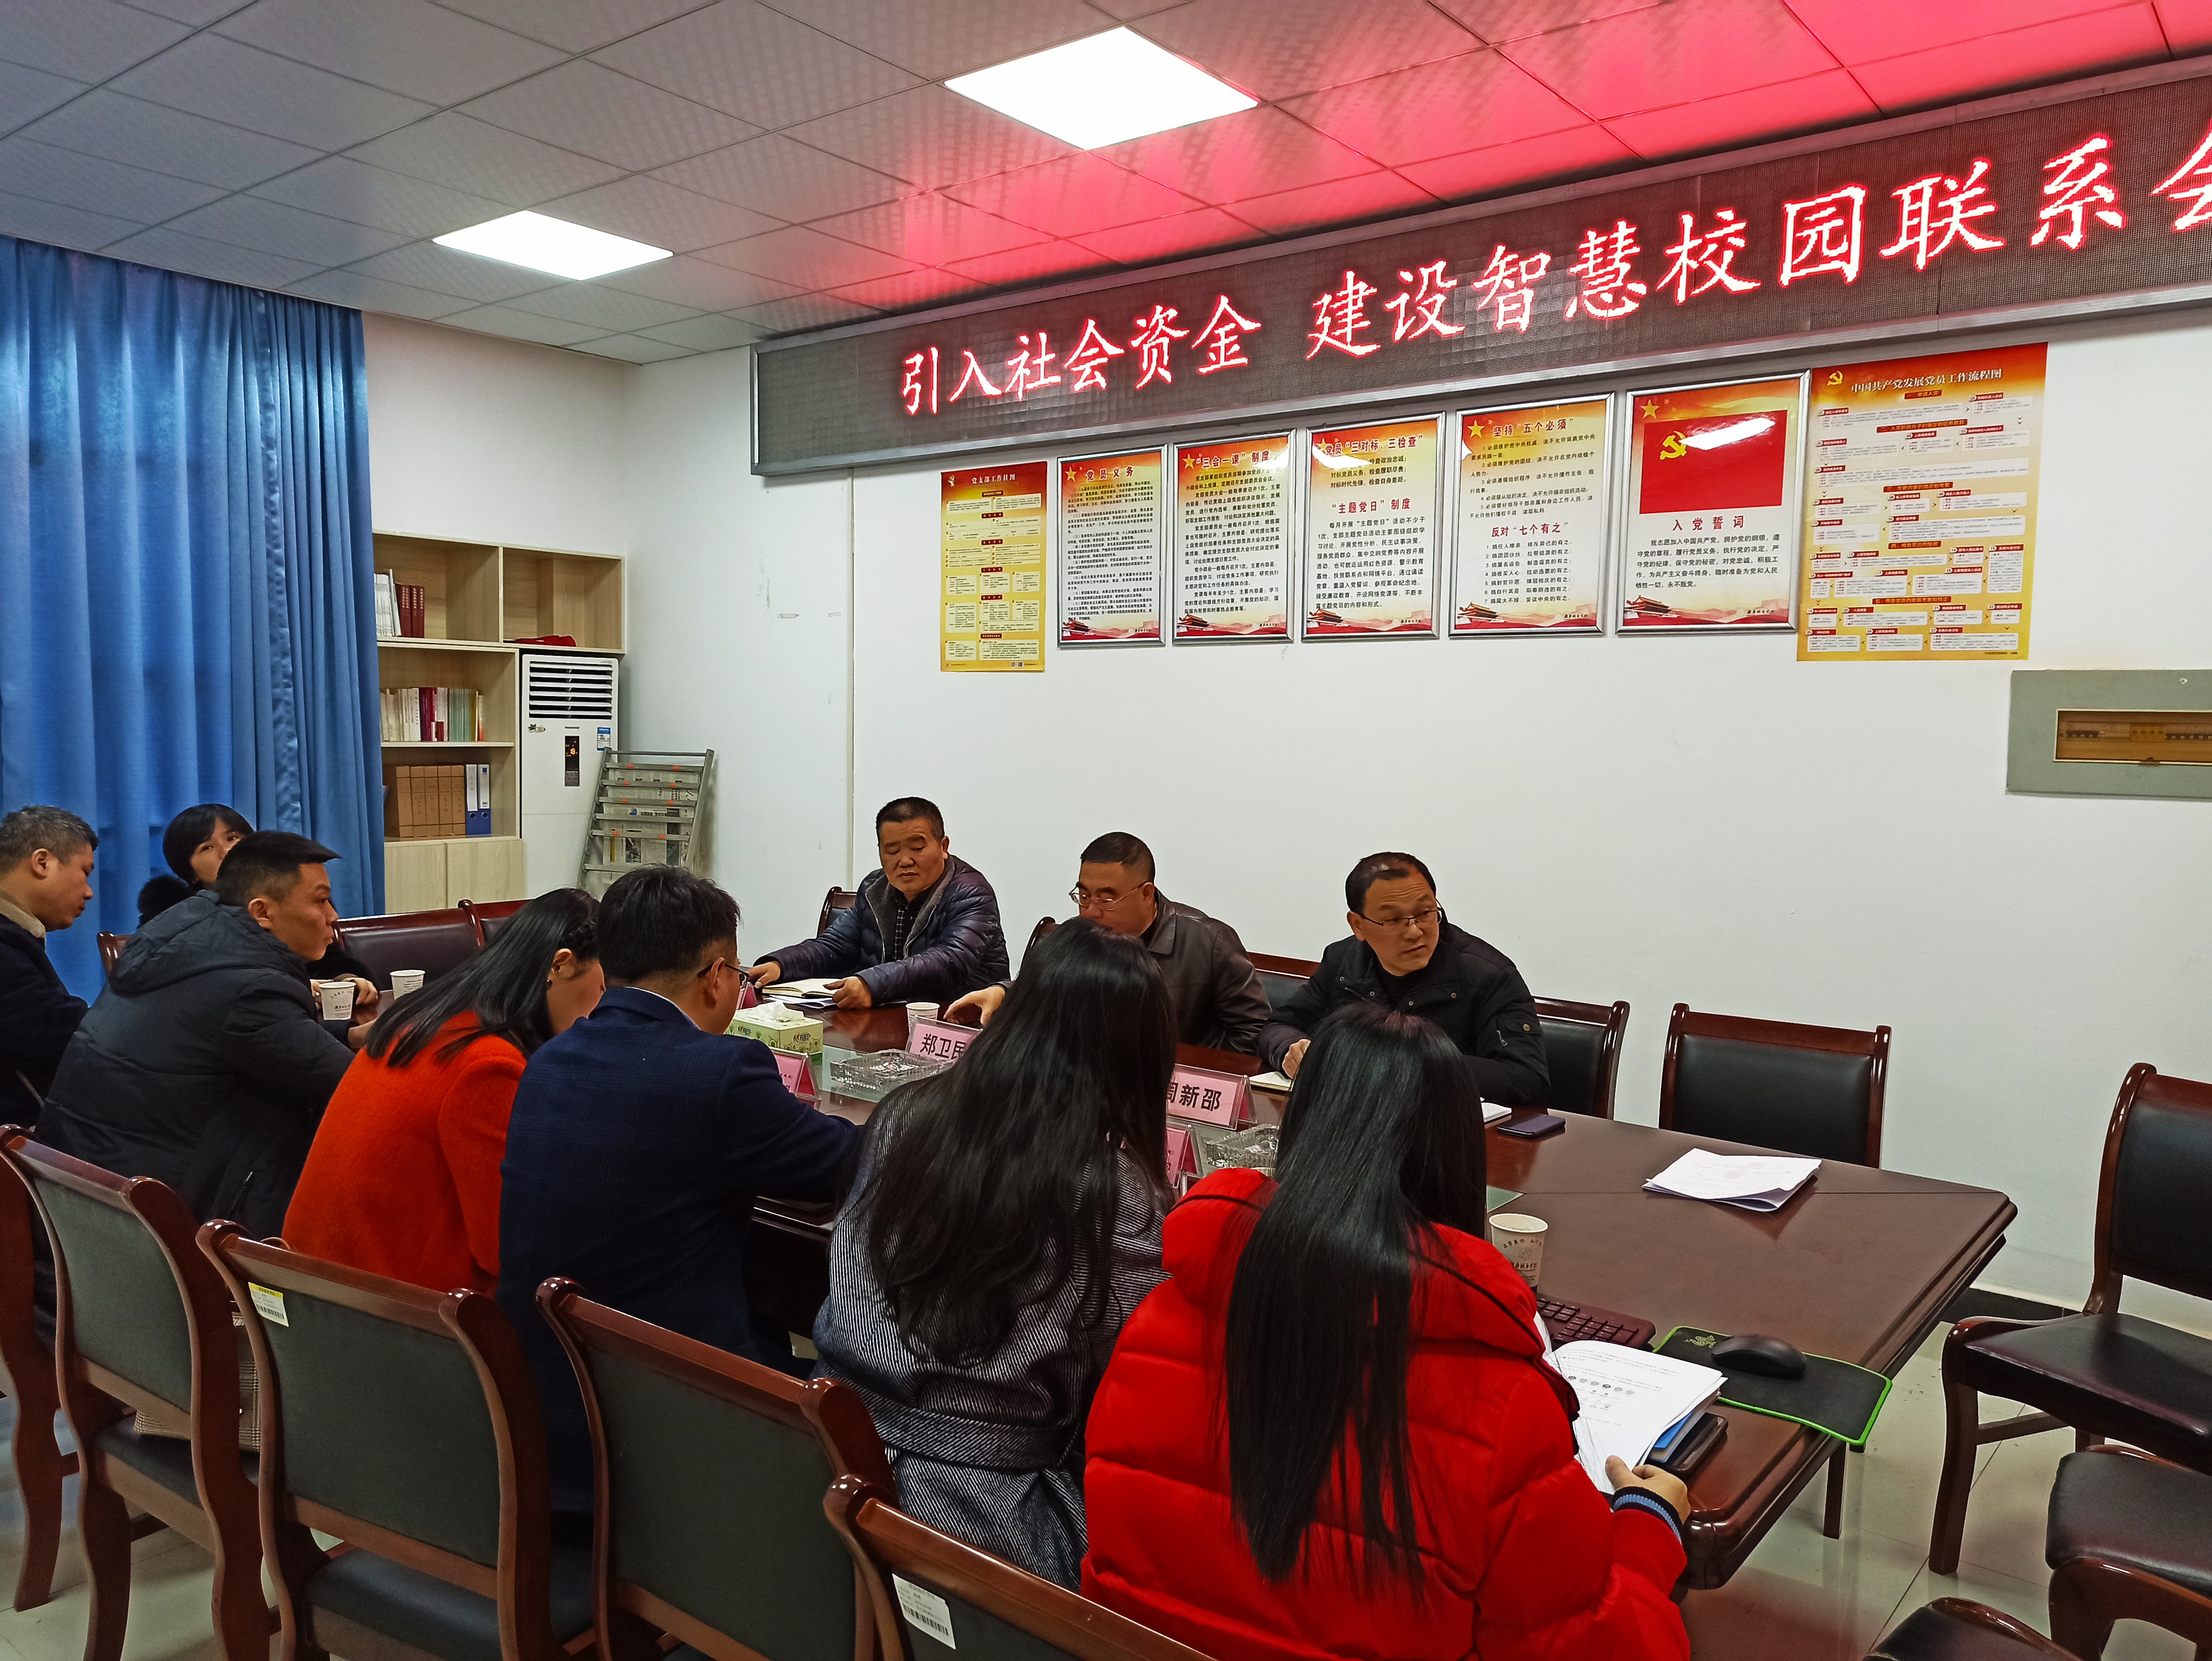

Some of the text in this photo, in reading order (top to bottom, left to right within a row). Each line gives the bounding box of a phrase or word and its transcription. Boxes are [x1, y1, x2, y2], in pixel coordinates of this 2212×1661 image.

[902, 295, 1261, 414] 引入社会资金
[1851, 368, 2002, 393] 中国共产党发展党员工作流程图
[1087, 466, 1133, 481] 党员义务
[1332, 498, 1410, 513] “主题党日”制度
[1491, 522, 1568, 537] 反对“七个有之”
[1672, 515, 1743, 531] 入党誓词
[920, 1033, 966, 1060] 郑卫民
